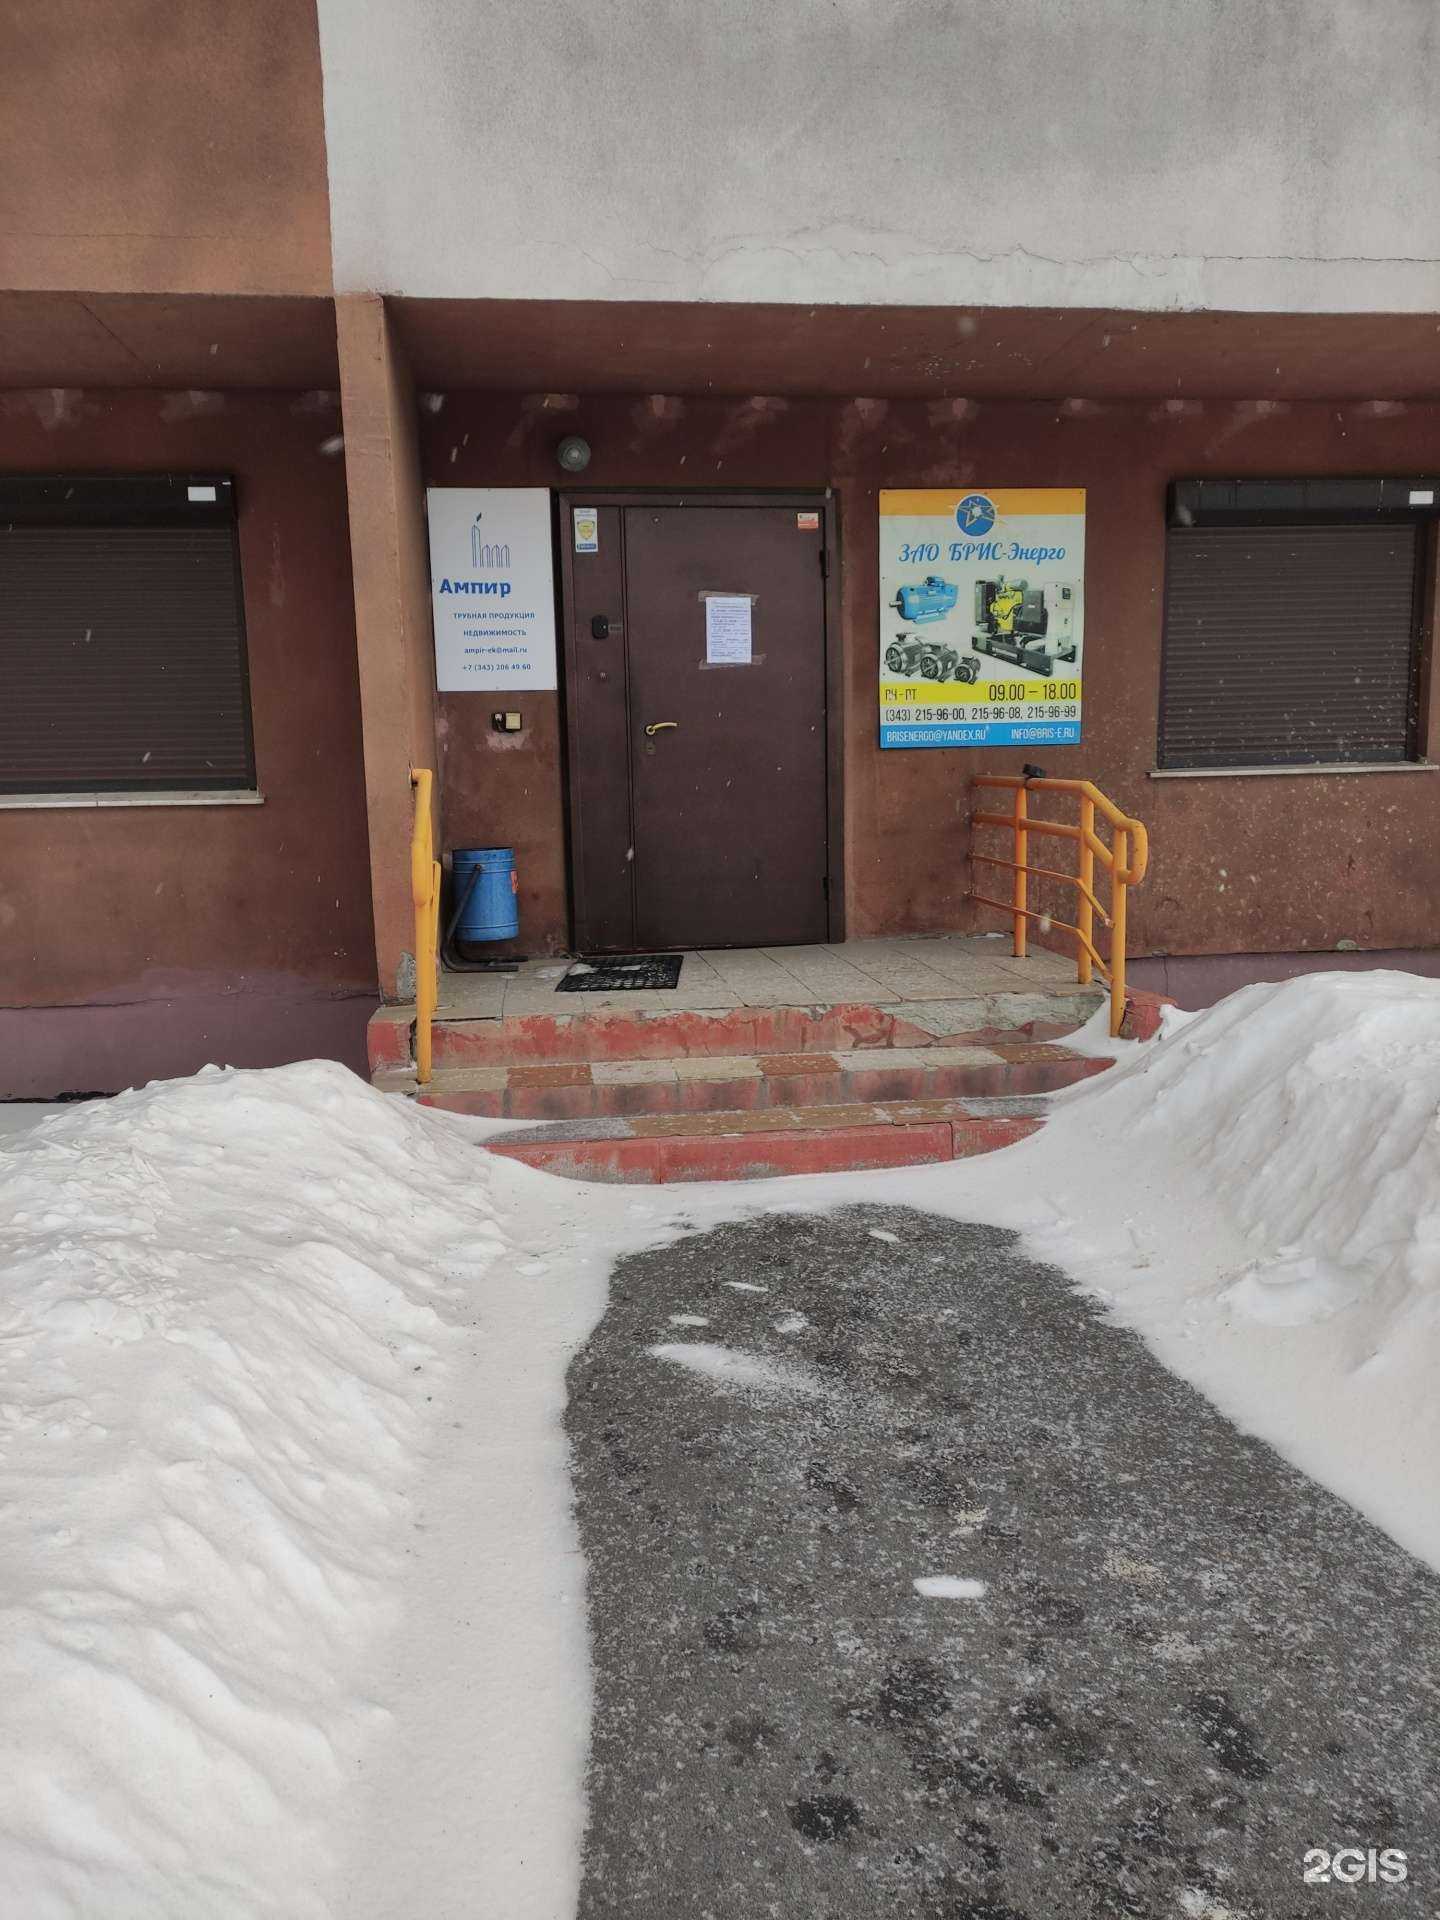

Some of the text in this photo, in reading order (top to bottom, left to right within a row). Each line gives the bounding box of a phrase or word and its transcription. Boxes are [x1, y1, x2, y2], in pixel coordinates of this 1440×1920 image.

[898, 541, 1066, 567] ЗАО БРИС-Энерго
[439, 578, 512, 598] Ампир
[453, 611, 535, 620] ТРУБНАЯ ПРОДУКЦИЯ
[463, 629, 527, 637] НЕДВИЖИМОСТЬ
[464, 646, 528, 655] ampir-ek@mail.ru
[462, 664, 472, 673] +7
[474, 664, 494, 673] (343)
[496, 664, 510, 672] 206
[522, 663, 532, 671] 60
[988, 683, 1026, 702] 09.00
[1043, 682, 1077, 700] 18.00
[885, 704, 1077, 723] (343) 215-96-00, 215-96-08, 215-96-99
[886, 726, 1075, 743] BRISENERGO@YANDEX.RU INFO@BRIS-E.RU
